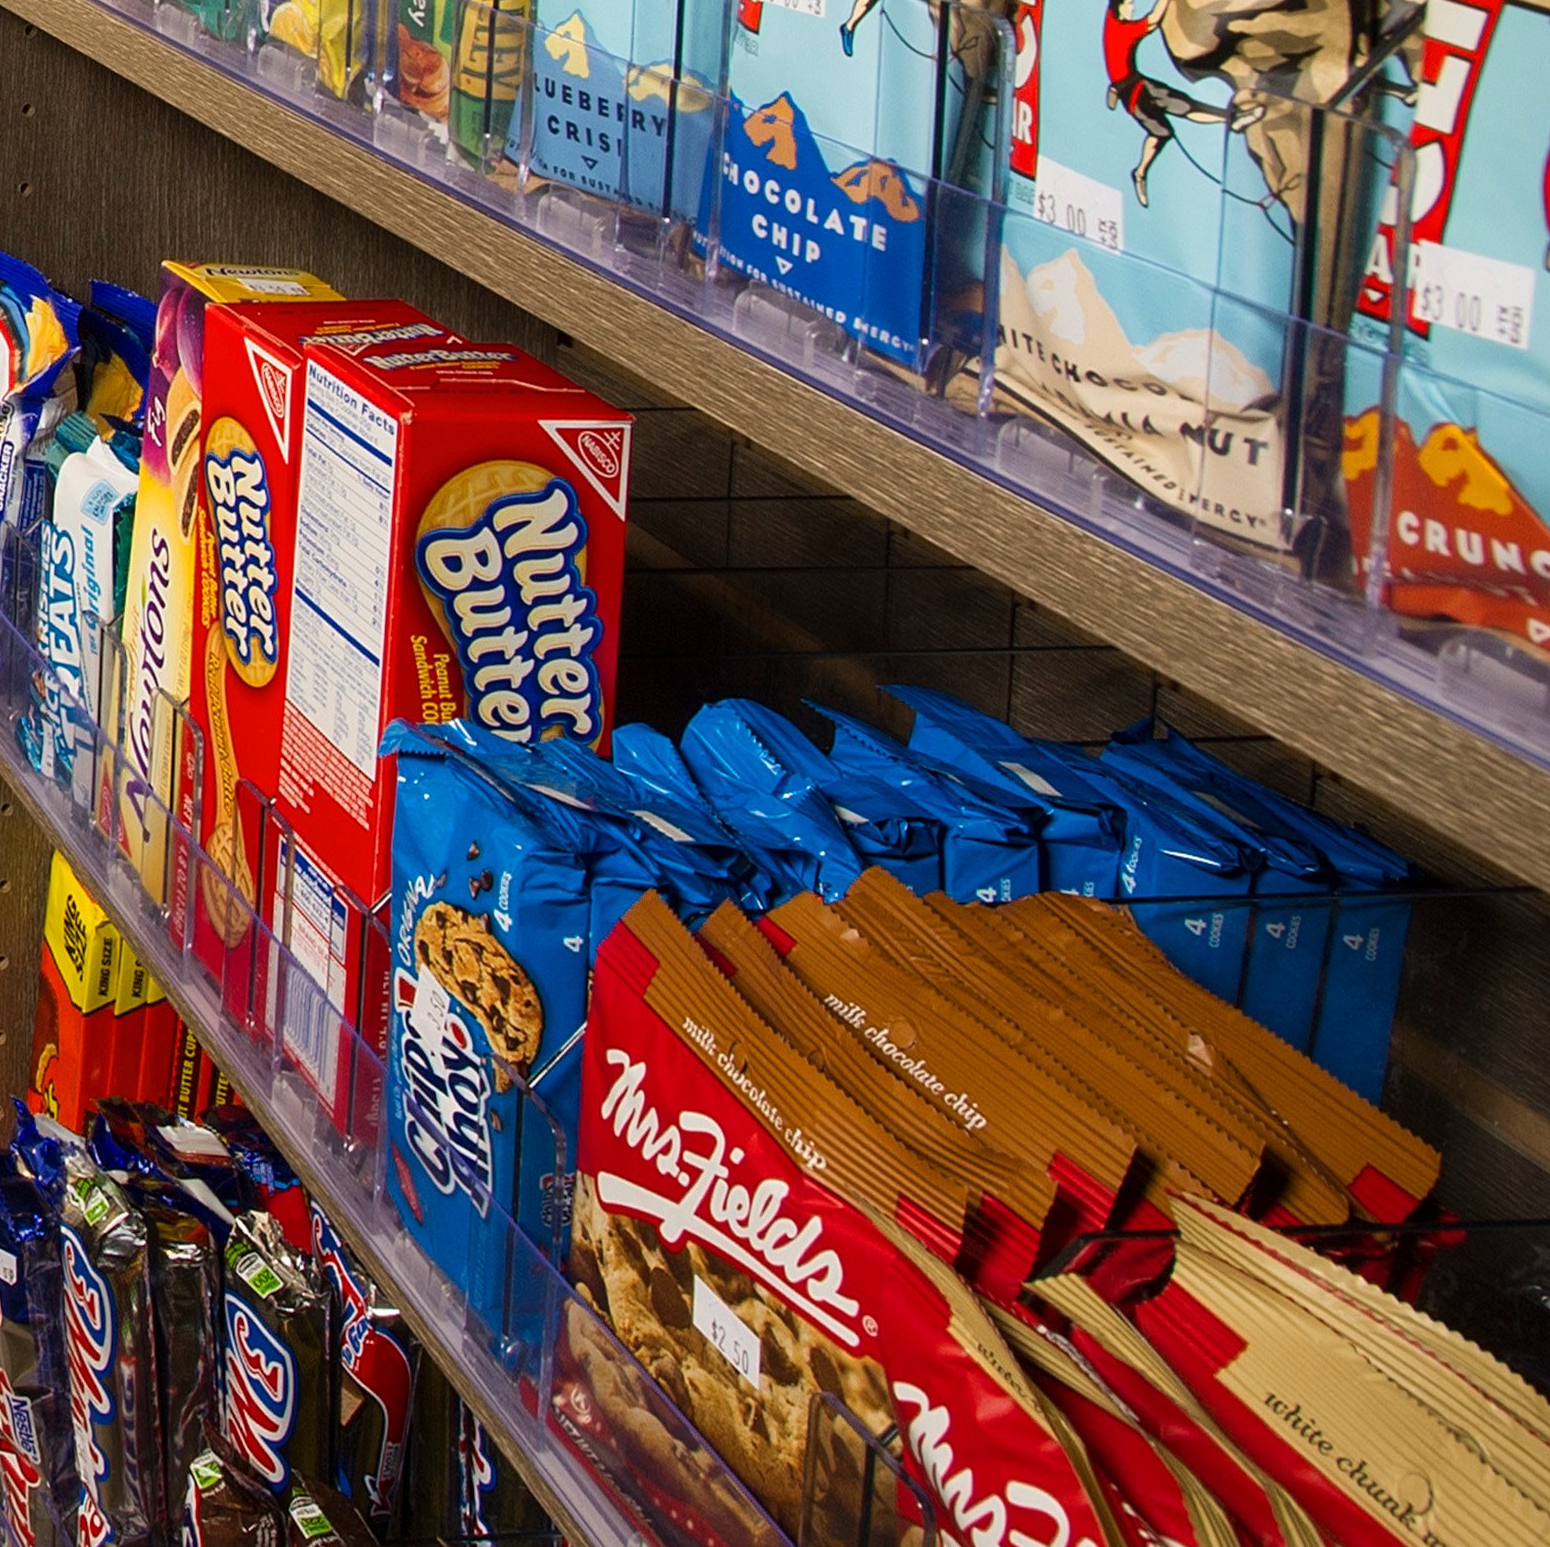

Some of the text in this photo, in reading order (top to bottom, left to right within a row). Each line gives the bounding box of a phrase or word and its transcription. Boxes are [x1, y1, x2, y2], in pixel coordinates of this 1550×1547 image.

[723, 151, 888, 253] CHOCOLATE
[752, 213, 821, 263] CHIP
[308, 365, 397, 437] Nutrition Facts
[580, 432, 617, 475] NABISCO
[204, 454, 252, 665] Butter
[229, 450, 277, 662] Nutter
[490, 487, 595, 736] Nutter
[1184, 918, 1207, 935] 4
[1208, 912, 1225, 949] COOKIES
[1265, 922, 1287, 939] 4
[1285, 914, 1301, 950] COOKIES
[1342, 933, 1365, 950] 4
[179, 1058, 195, 1103] BUTTER
[822, 992, 989, 1132] milk chocolate chip
[682, 1016, 717, 1056] milk
[783, 1126, 828, 1172] chip
[1263, 1391, 1418, 1533] white chunk
